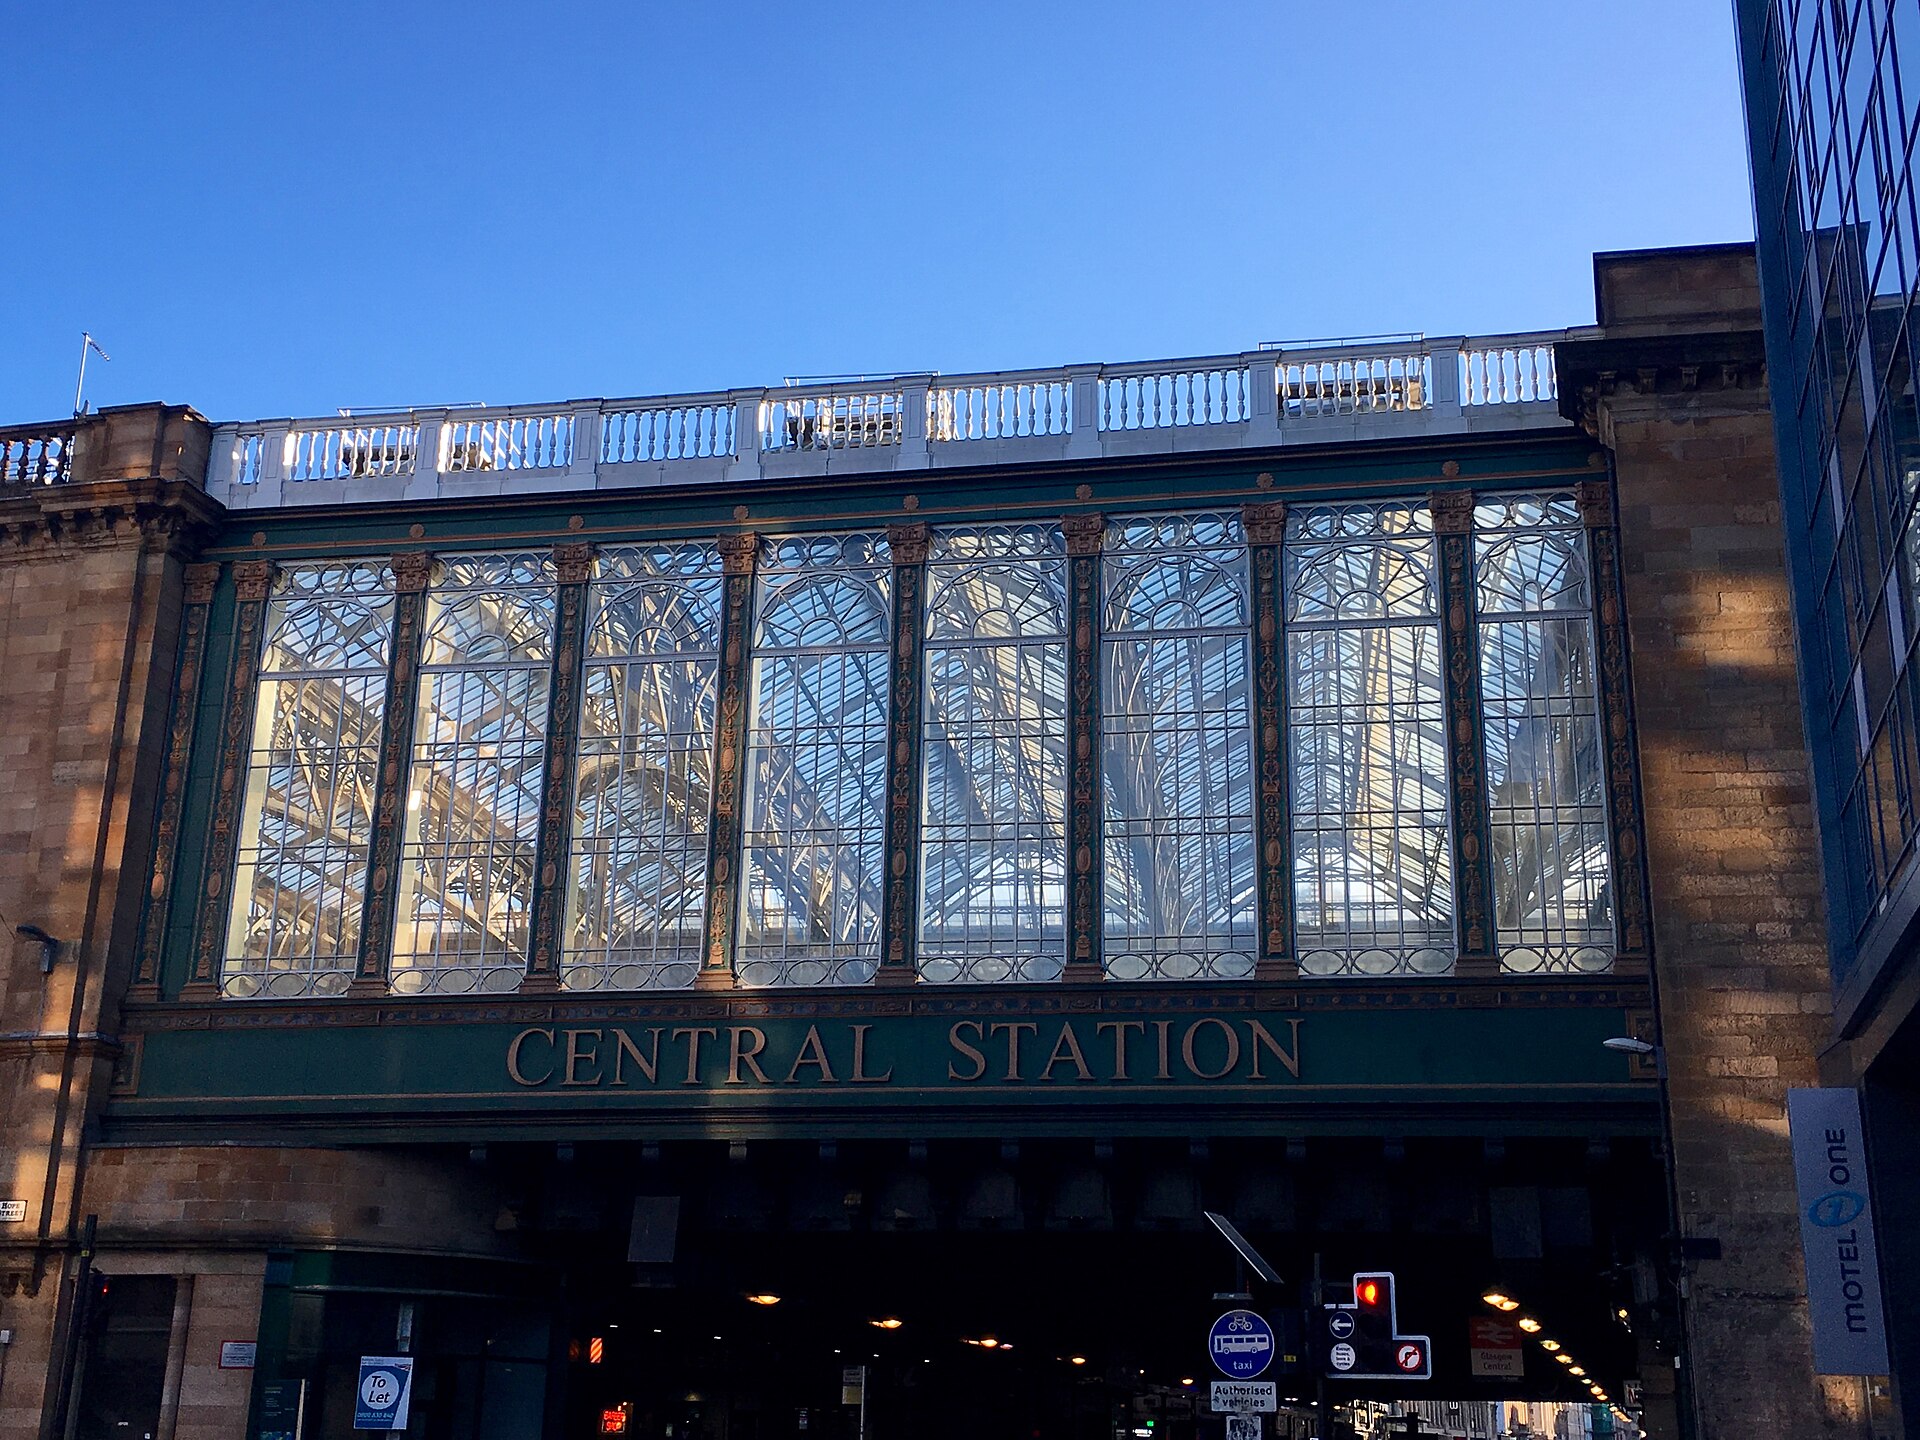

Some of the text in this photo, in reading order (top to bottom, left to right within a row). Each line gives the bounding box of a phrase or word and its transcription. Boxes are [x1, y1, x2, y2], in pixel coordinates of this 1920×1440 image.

[506, 1017, 1305, 1086] CENTRAL STATION
[1480, 1351, 1513, 1361] Glasgow
[1233, 1360, 1253, 1370] taxi
[1483, 1362, 1511, 1370] Central
[371, 1375, 386, 1388] To
[1214, 1385, 1272, 1395] Authorised
[368, 1391, 390, 1403] Let
[1222, 1397, 1265, 1408] vehicles
